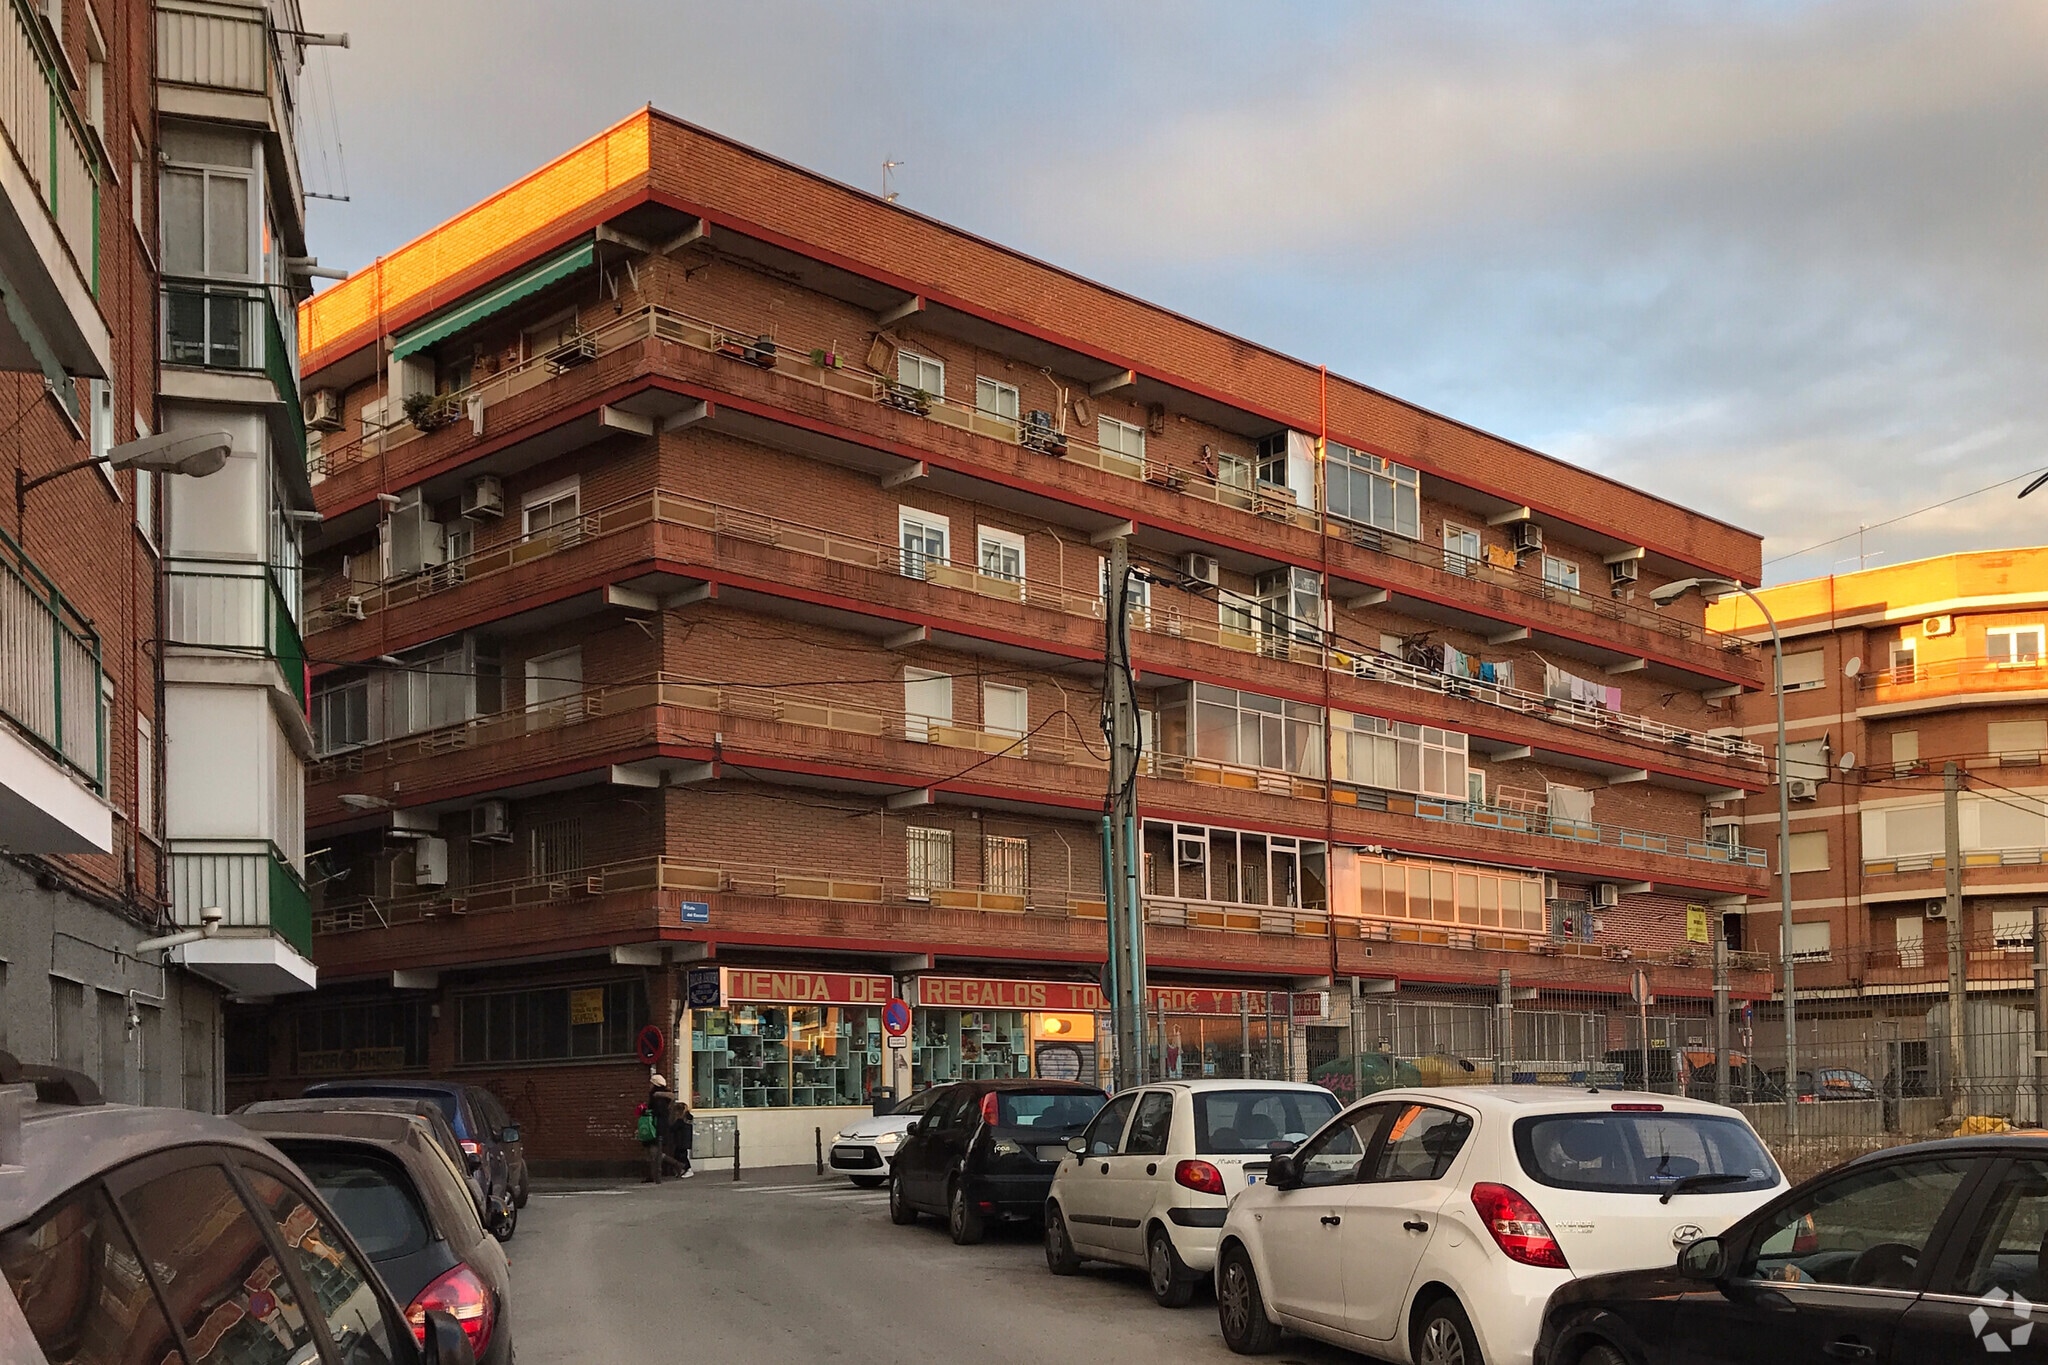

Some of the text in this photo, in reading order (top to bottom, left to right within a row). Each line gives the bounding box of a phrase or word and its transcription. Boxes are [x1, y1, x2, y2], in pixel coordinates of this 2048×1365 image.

[728, 972, 831, 1000] TIENDA
[850, 977, 886, 1002] DE
[926, 979, 1046, 1007] REGALOS
[1212, 992, 1223, 1012] Y
